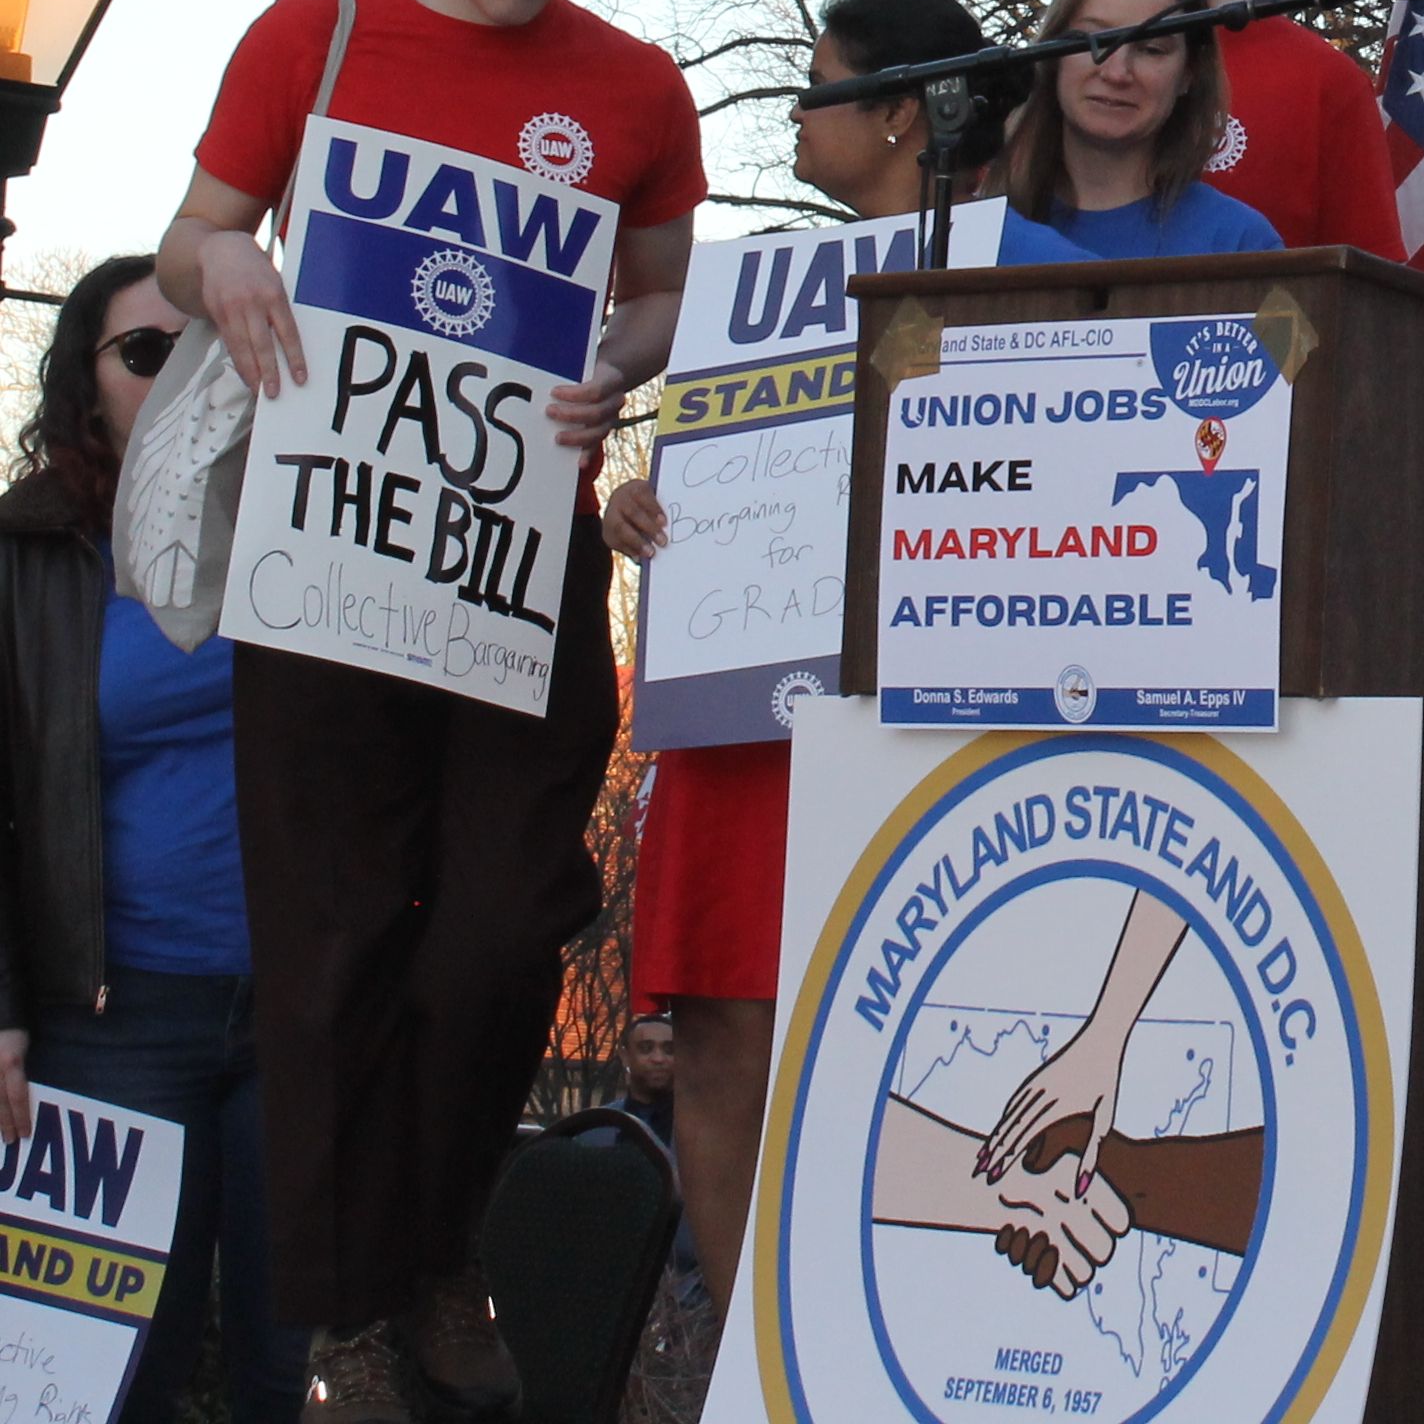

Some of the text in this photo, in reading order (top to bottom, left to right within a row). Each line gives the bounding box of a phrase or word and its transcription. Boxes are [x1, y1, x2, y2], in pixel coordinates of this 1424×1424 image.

[541, 139, 573, 158] UAW
[324, 137, 602, 278] UAW
[435, 283, 473, 306] UAW
[971, 332, 1006, 352] State
[1010, 331, 1020, 349] &
[1025, 330, 1046, 349] DC
[1050, 327, 1114, 349] AFL-CIO
[1185, 321, 1258, 356] IT'S BETTER
[1212, 342, 1231, 353] IN A
[674, 361, 857, 424] STAND
[1173, 355, 1267, 401] Union
[331, 325, 533, 505] PASS
[901, 388, 1169, 429] UNION JOBS
[896, 459, 1033, 495] MAKE
[668, 494, 796, 545] Bargaining
[274, 454, 556, 636] THE BILL
[762, 537, 814, 568] for
[893, 524, 1158, 561] MARYLAND
[250, 550, 551, 701] Collective Bargaining
[688, 576, 845, 639] GRAD
[889, 593, 1193, 628] AFFORDABLE
[913, 689, 1019, 704] Donna S. Edwards
[1136, 690, 1246, 709] Samuel A. Epps IV
[855, 785, 1316, 1067] MARYLAND STATE AND D.C.
[86, 1258, 146, 1303] UP
[995, 1347, 1063, 1375] MERGED
[944, 1377, 1103, 1414] SEPTEMBER 6, 1957
